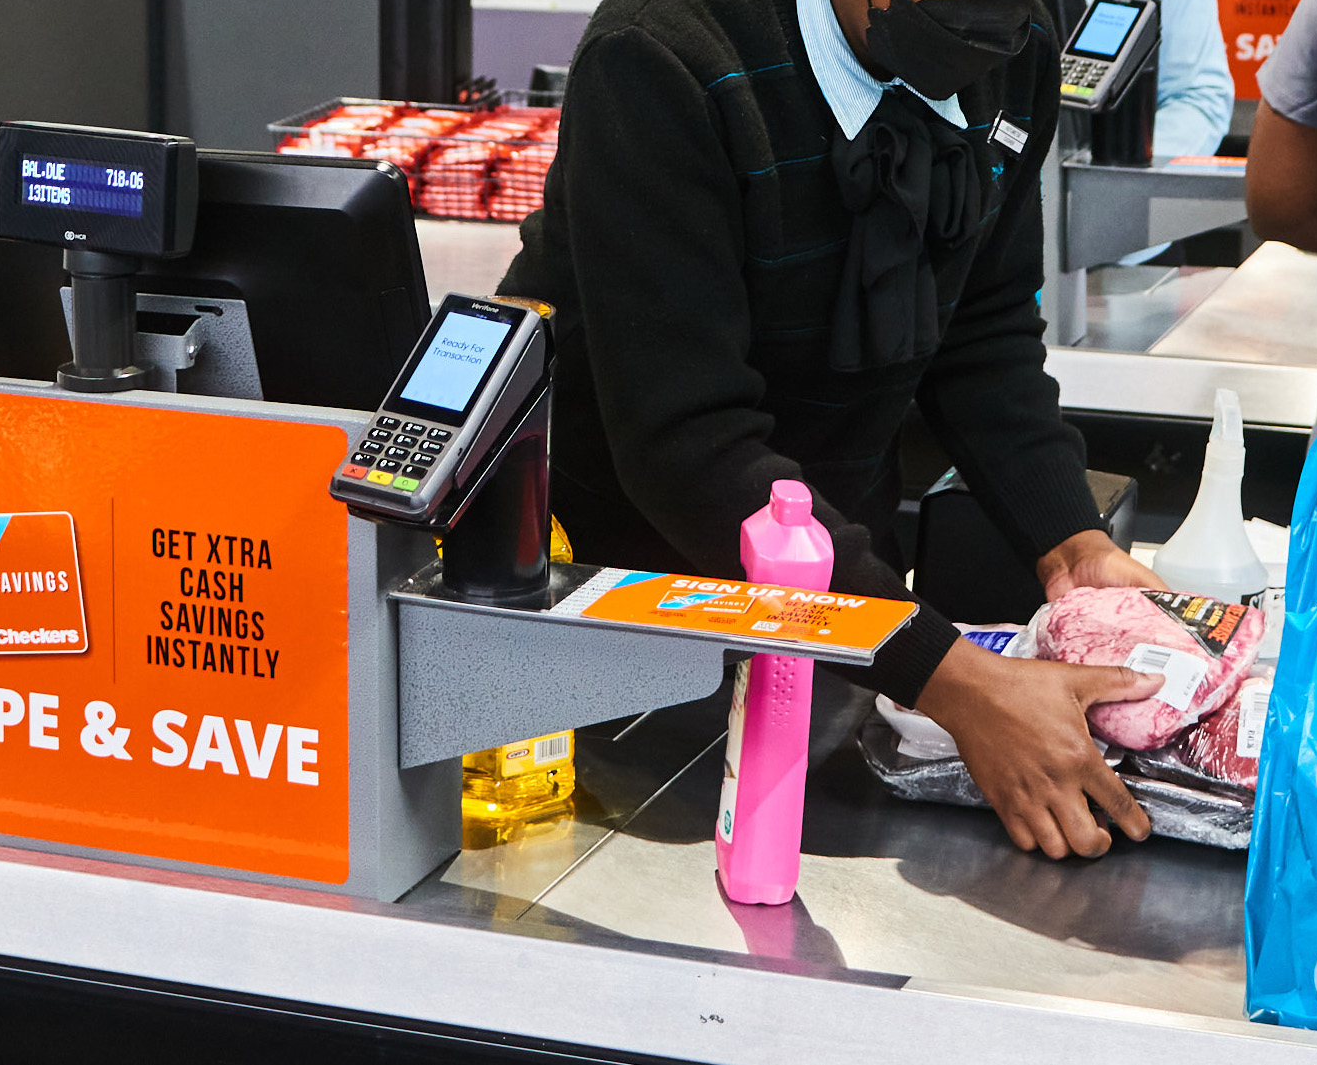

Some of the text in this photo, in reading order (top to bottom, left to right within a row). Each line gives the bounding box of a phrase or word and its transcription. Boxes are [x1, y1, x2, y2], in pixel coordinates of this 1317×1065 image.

[22, 159, 144, 190] BAL.DUE 718.06
[471, 302, 500, 314] Verifone
[433, 347, 482, 365] Transaction
[441, 337, 485, 353] Ready For
[152, 528, 272, 570] GET XTRA
[180, 567, 244, 603] CASH
[671, 579, 867, 608] SIGN UP NOW
[778, 611, 829, 621] SAVINGS
[793, 607, 824, 615] CASH
[812, 604, 842, 612] XTRA
[160, 601, 265, 641] SAVINGS
[766, 614, 832, 626] INSTANTLY
[147, 635, 280, 680] INSTANTLY
[80, 700, 133, 761] &
[151, 709, 320, 787] SAVE
